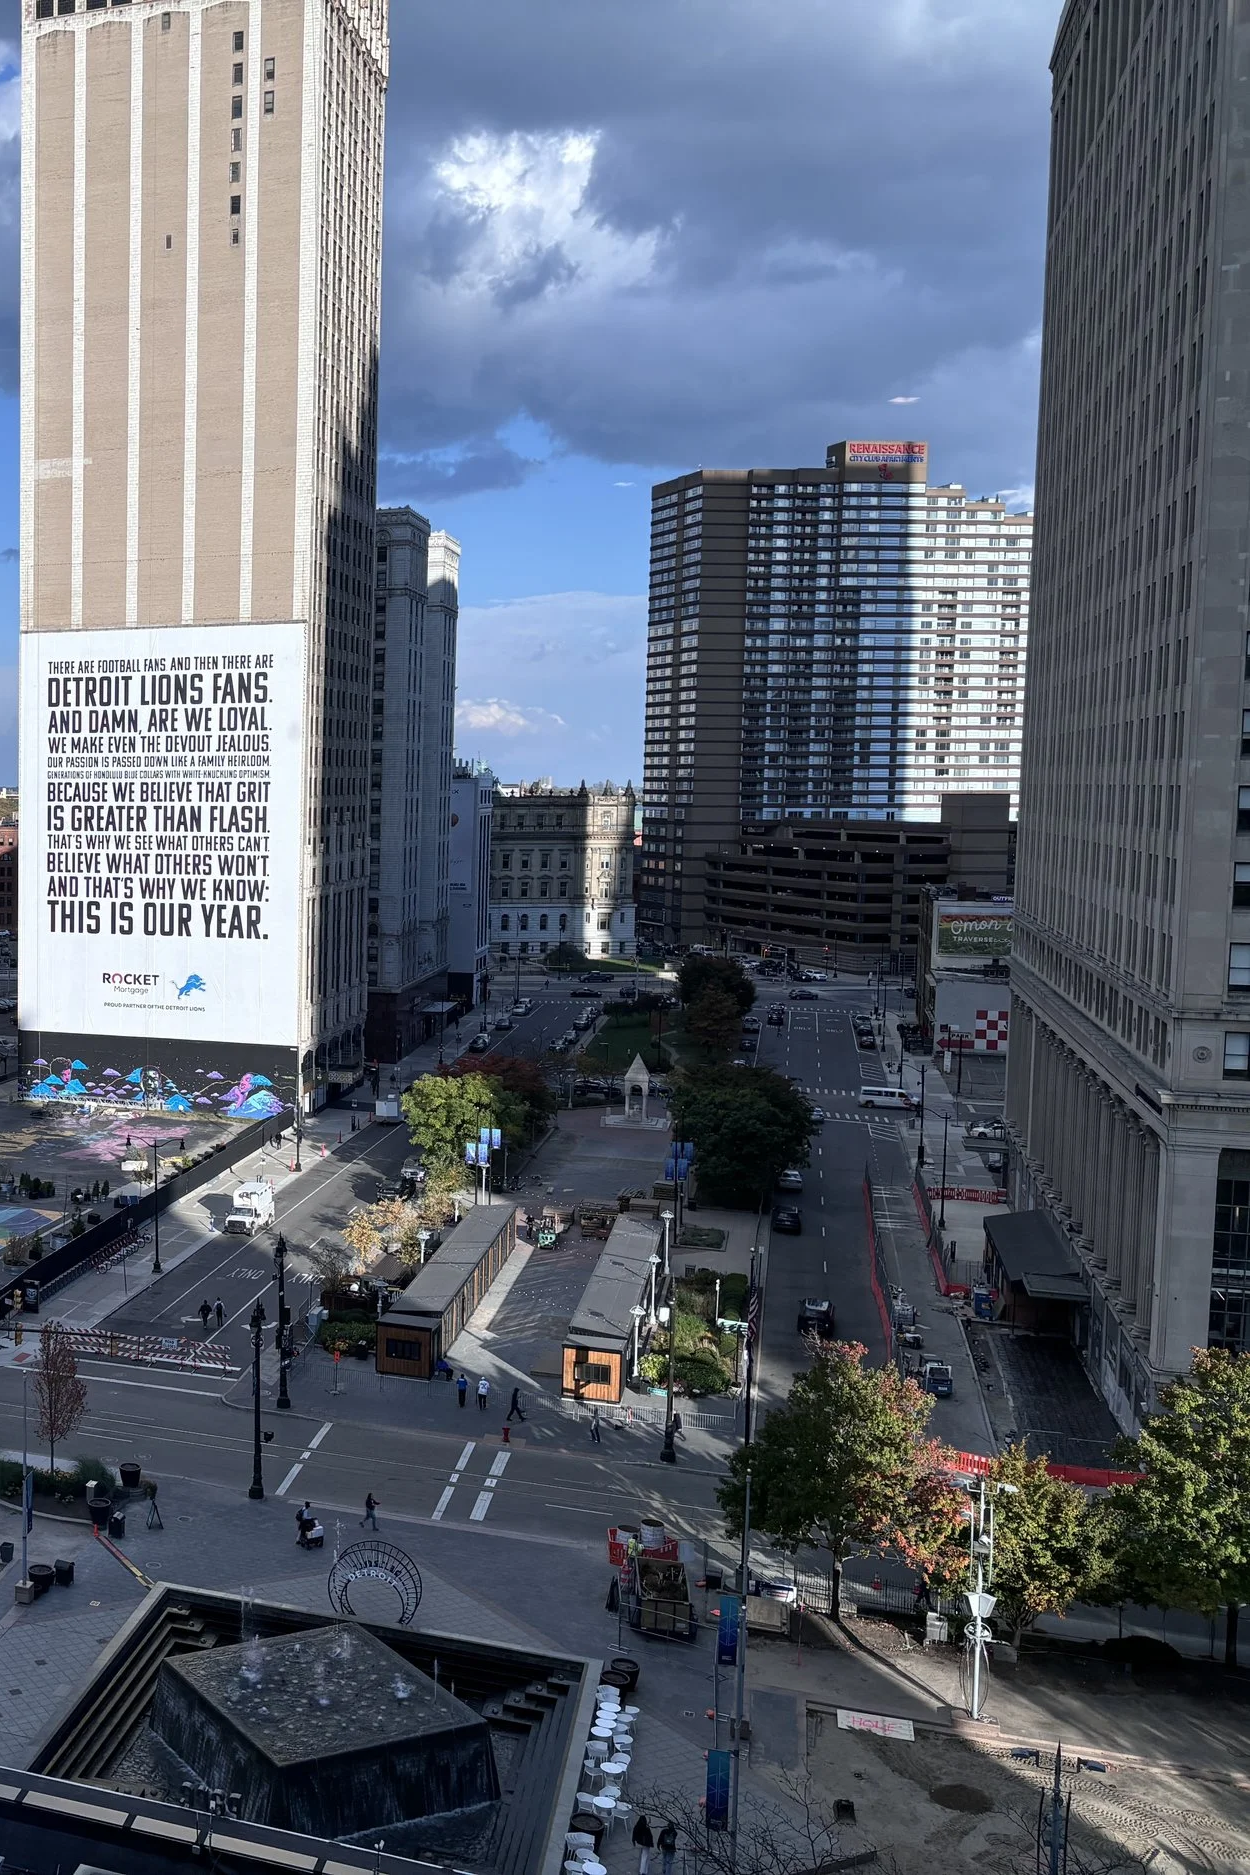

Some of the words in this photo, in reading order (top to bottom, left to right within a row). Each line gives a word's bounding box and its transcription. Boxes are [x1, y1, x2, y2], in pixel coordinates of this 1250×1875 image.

[849, 443, 925, 455] RENAISSANCE
[48, 661, 74, 674] THERE
[77, 660, 94, 674] ARE
[98, 659, 140, 673] FOOTBALL
[170, 657, 190, 671] AND
[193, 656, 218, 671] THEN
[222, 655, 251, 670] THERE
[254, 654, 273, 669] ARE
[47, 675, 132, 707] DETROIT
[140, 673, 203, 706] LIONS
[212, 671, 273, 704] FANS.
[48, 710, 81, 734] AND
[89, 709, 142, 735] DAMN,
[147, 708, 177, 732] ARE
[184, 708, 211, 732] WE
[219, 707, 272, 732] LOYAL.
[47, 737, 66, 754] WE
[70, 737, 104, 753] MAKE
[107, 736, 136, 753] EVEN
[140, 736, 160, 753] THE
[165, 735, 212, 753] DEVOUT
[215, 734, 272, 752] JEALOUS.
[47, 757, 63, 768] OUR
[65, 756, 98, 768] PASSION
[101, 756, 109, 768] IS
[111, 756, 141, 768] PASSED
[144, 756, 168, 767] DOWN
[171, 756, 187, 767] LIKE
[189, 756, 195, 767] A
[197, 755, 225, 767] FAMILY
[227, 755, 272, 767] HEIRLOOM.
[47, 771, 84, 779] GENERATIONS
[85, 771, 92, 779] OF
[94, 771, 122, 779] HONOLULU
[124, 771, 137, 779] BLUE
[139, 770, 163, 779] COLLARS
[164, 770, 180, 779] WITH
[182, 770, 237, 779] WHITE-KNUCKLING
[47, 782, 107, 802] BECAUSE
[112, 782, 134, 802] WE
[140, 782, 192, 802] BELIEVE
[196, 782, 232, 802] THAT
[237, 782, 270, 802] GRIT
[47, 806, 64, 831] IS
[71, 806, 146, 832] GREATER
[153, 806, 201, 833] THAN
[209, 806, 271, 833] FLASH.
[47, 835, 82, 850] THAT'S
[85, 835, 110, 850] WHY
[114, 836, 131, 850] WE
[134, 836, 153, 850] SEE
[155, 836, 188, 851] WHAT
[192, 836, 233, 851] OTHERS
[46, 853, 101, 874] BELIEVE
[105, 854, 150, 874] WHAT
[154, 854, 212, 876] OTHERS
[46, 876, 78, 898] AND
[83, 877, 133, 899] THAT'S
[138, 878, 176, 900] WHY
[180, 879, 206, 901] WE
[212, 879, 269, 902] KNOW:
[46, 901, 100, 934] THIS
[110, 902, 133, 935] IS
[143, 903, 191, 937] OUR
[200, 904, 268, 940] YEAR.
[102, 972, 160, 986] ROCKET
[113, 985, 149, 995] Mortgage
[226, 1268, 265, 1280] ONLY
[348, 1569, 398, 1587] DETROIT
